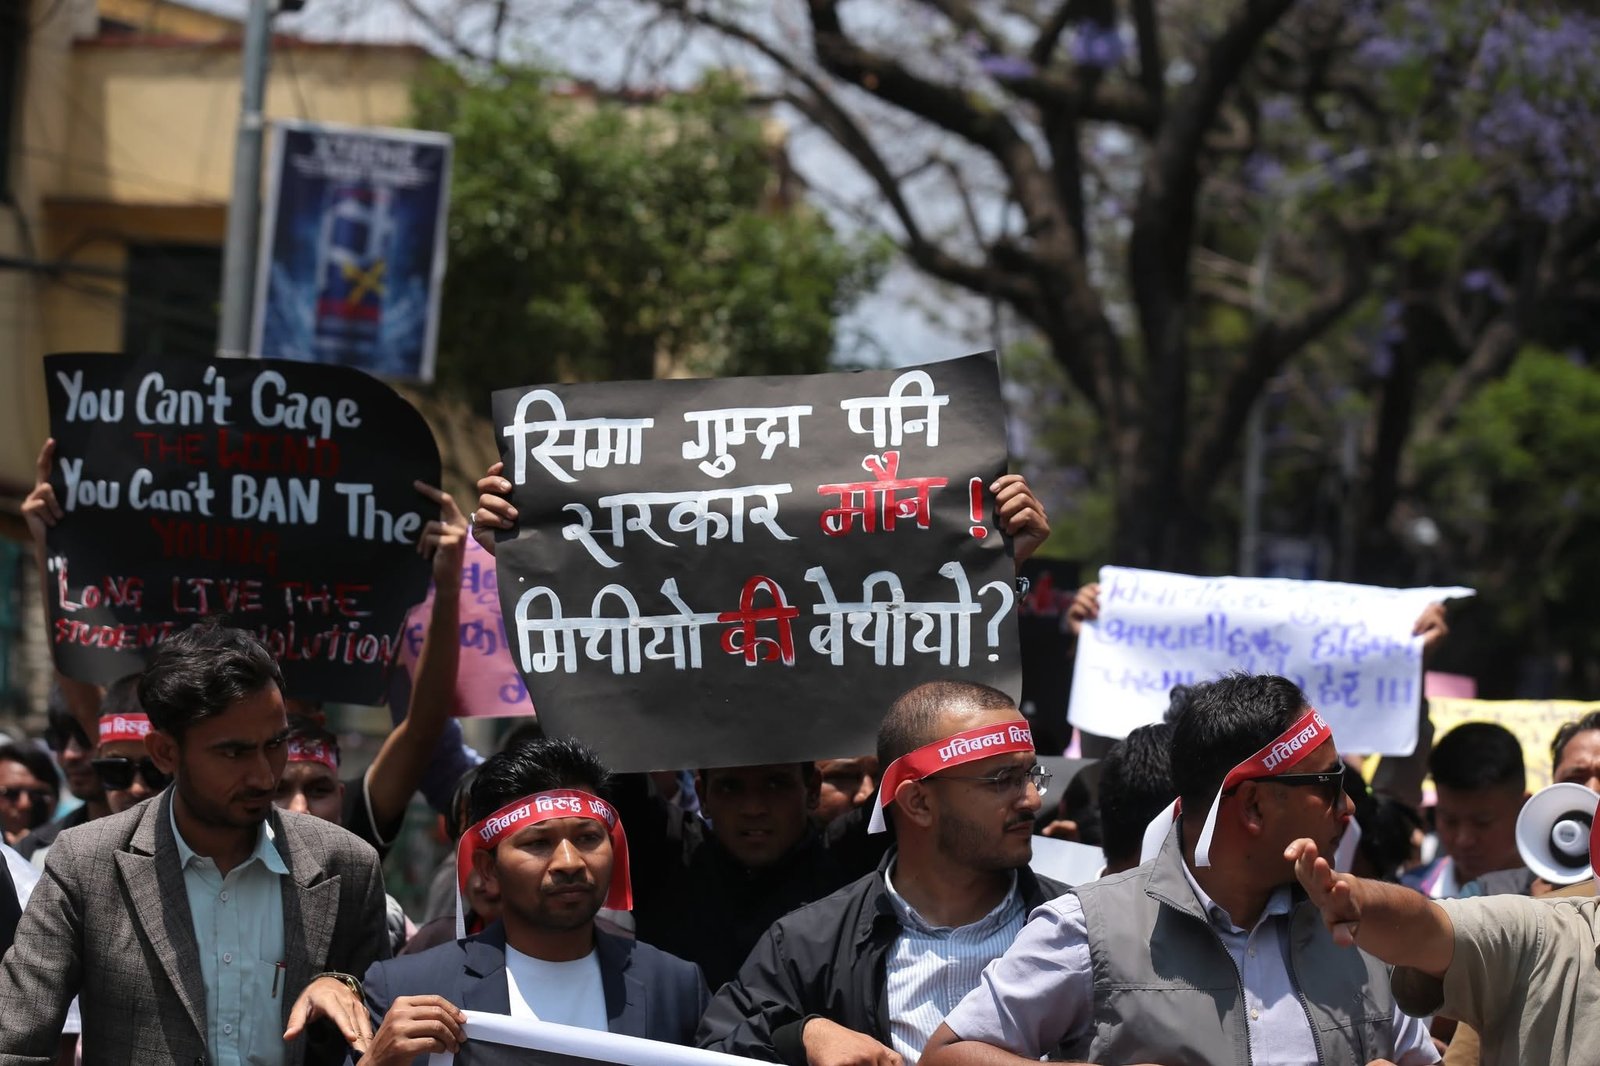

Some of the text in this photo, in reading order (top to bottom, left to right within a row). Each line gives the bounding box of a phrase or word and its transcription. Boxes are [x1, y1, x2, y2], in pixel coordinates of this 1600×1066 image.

[57, 365, 362, 446] You Can't Cage
[503, 389, 655, 485] सिमा
[840, 370, 950, 449] पनि
[134, 427, 342, 478] THE WIND
[60, 458, 423, 545] You Can't BAN The
[562, 483, 800, 569] सरकार
[817, 450, 950, 537] मौन
[151, 516, 280, 575] YOUNG
[171, 575, 263, 617] LIVE
[272, 582, 373, 619] THE
[54, 618, 181, 652] STUDENT
[515, 577, 718, 675] मिचीयो
[717, 575, 800, 668] की
[937, 731, 1006, 763] प्रतिबन्ध
[1261, 722, 1319, 772] प्रतिबन्ध
[479, 803, 531, 843] प्रतिबन्ध
